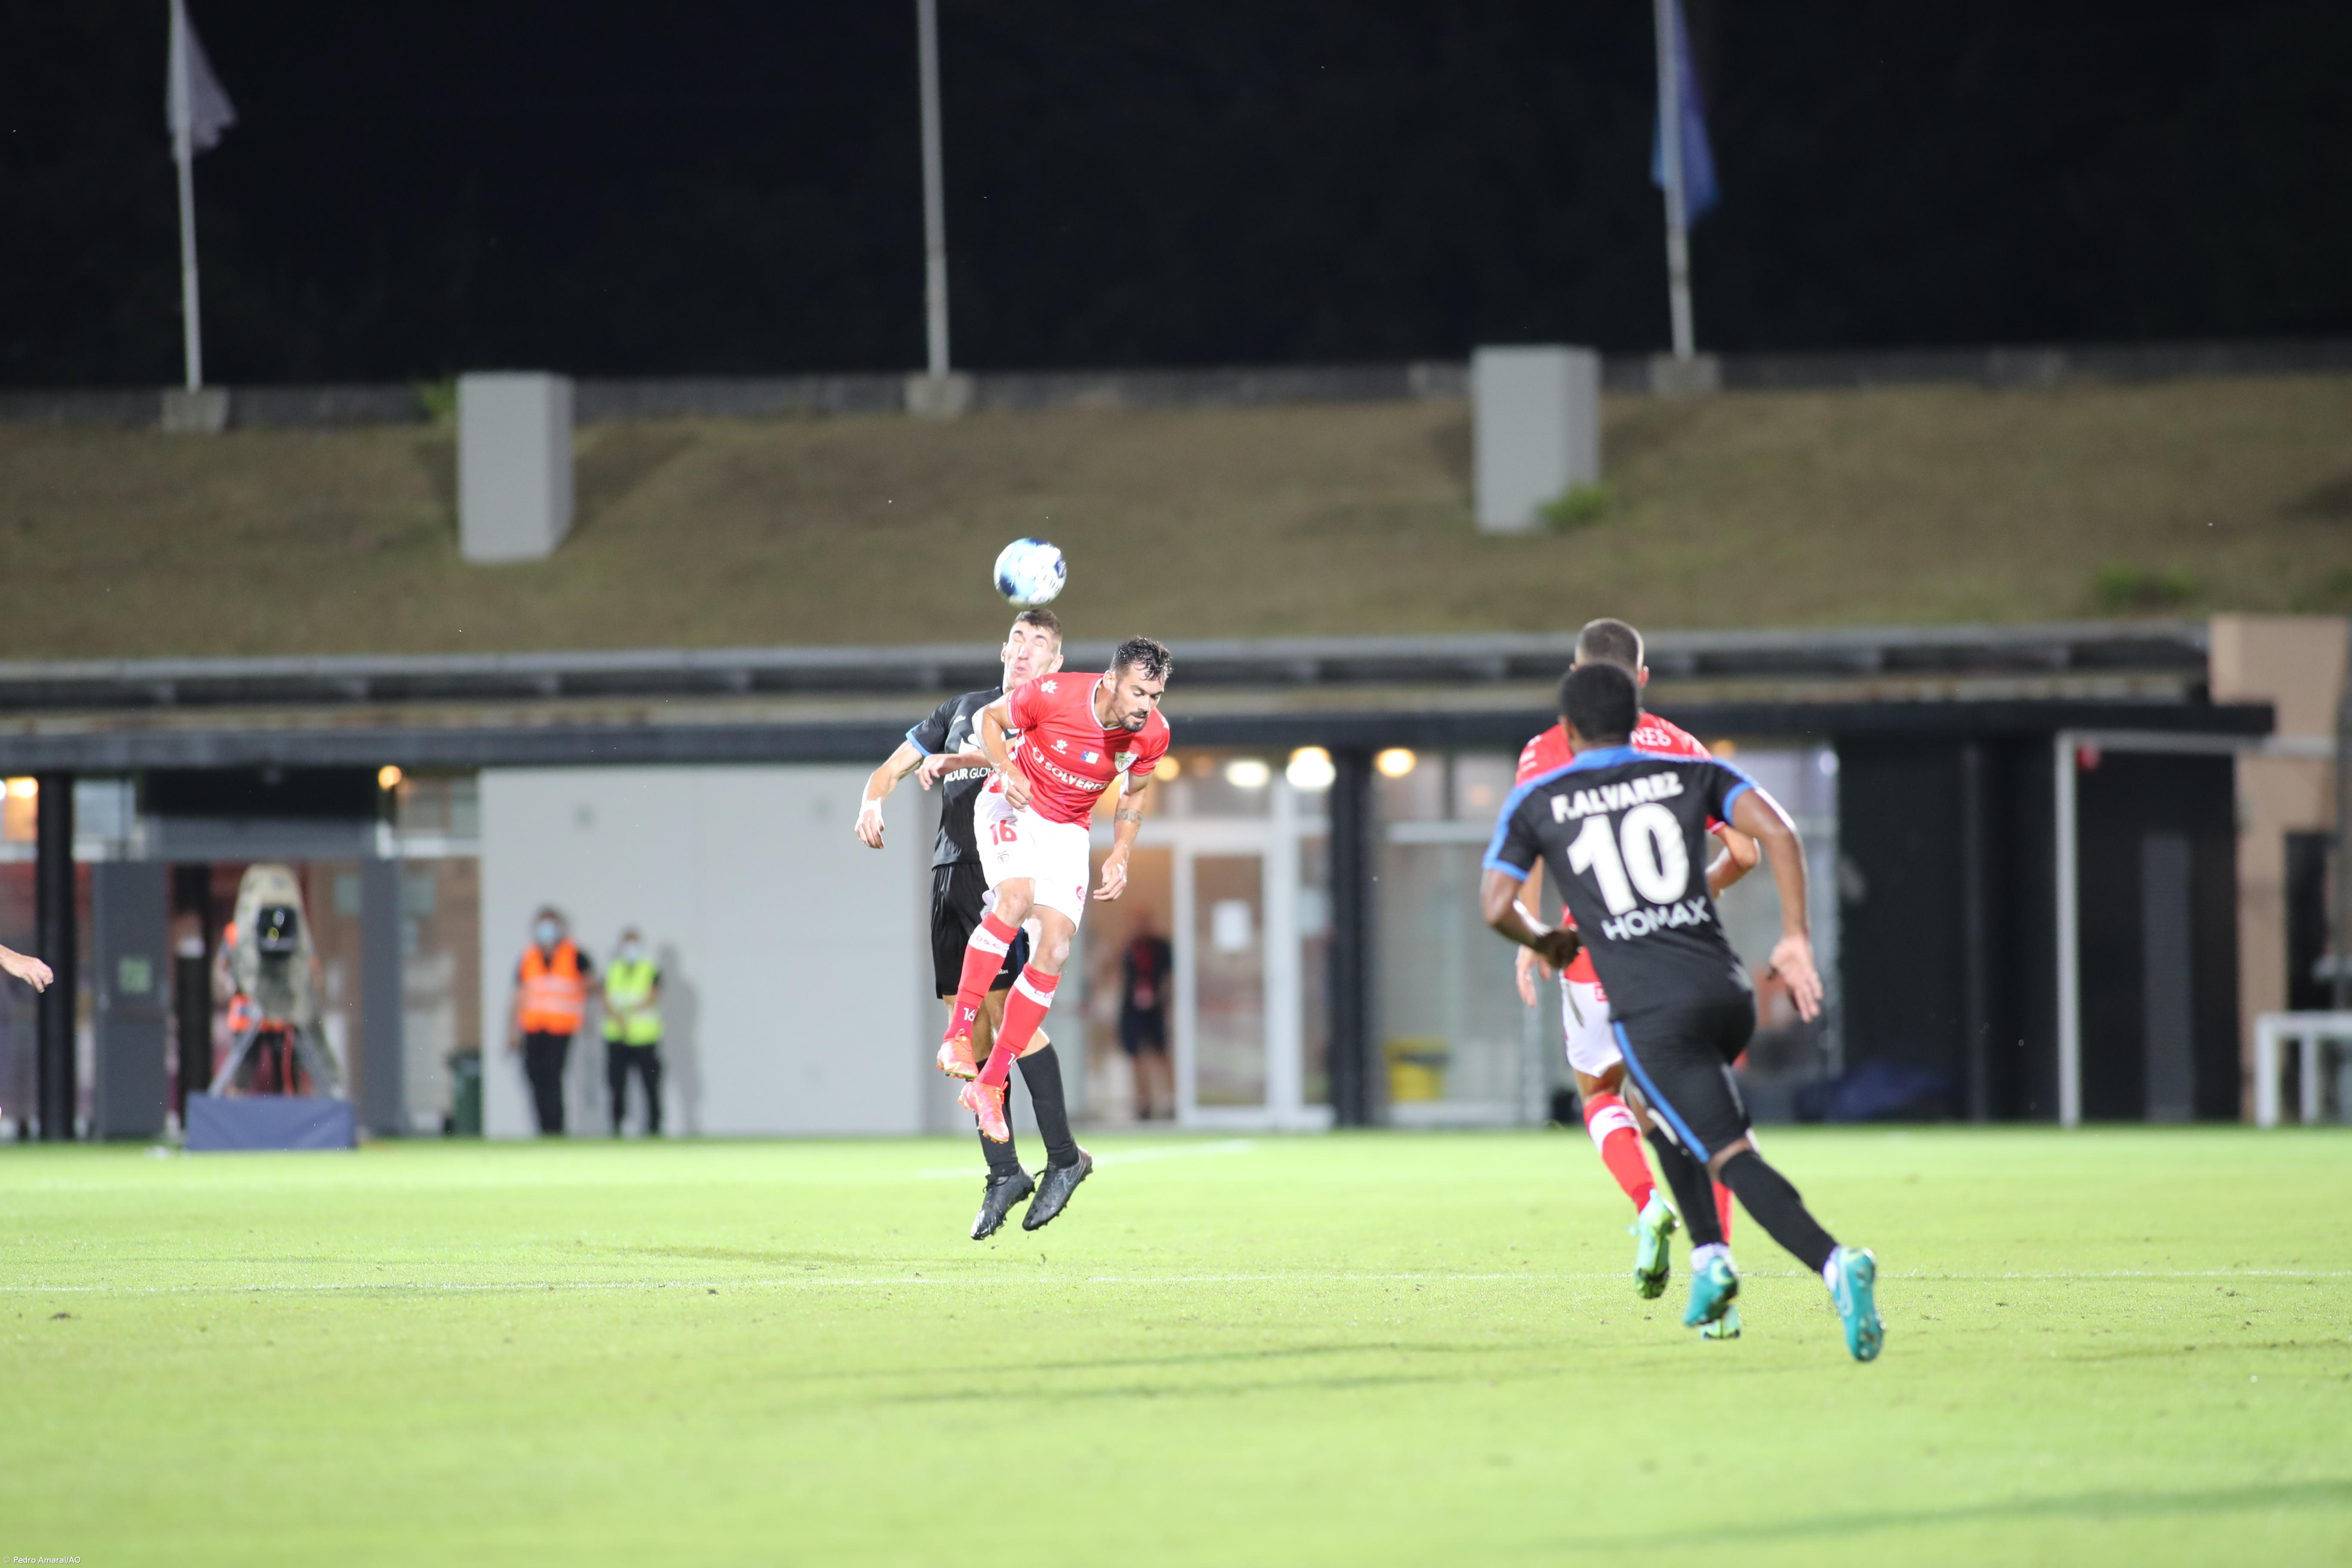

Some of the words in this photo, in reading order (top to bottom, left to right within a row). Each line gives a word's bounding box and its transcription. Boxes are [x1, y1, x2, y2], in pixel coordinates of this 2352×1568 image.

[1550, 771, 1684, 824] F.ALVAREZ
[989, 819, 1017, 846] 16
[1566, 802, 1690, 916] 10
[1600, 896, 1711, 941] HOMAX
[963, 1007, 976, 1021] 16
